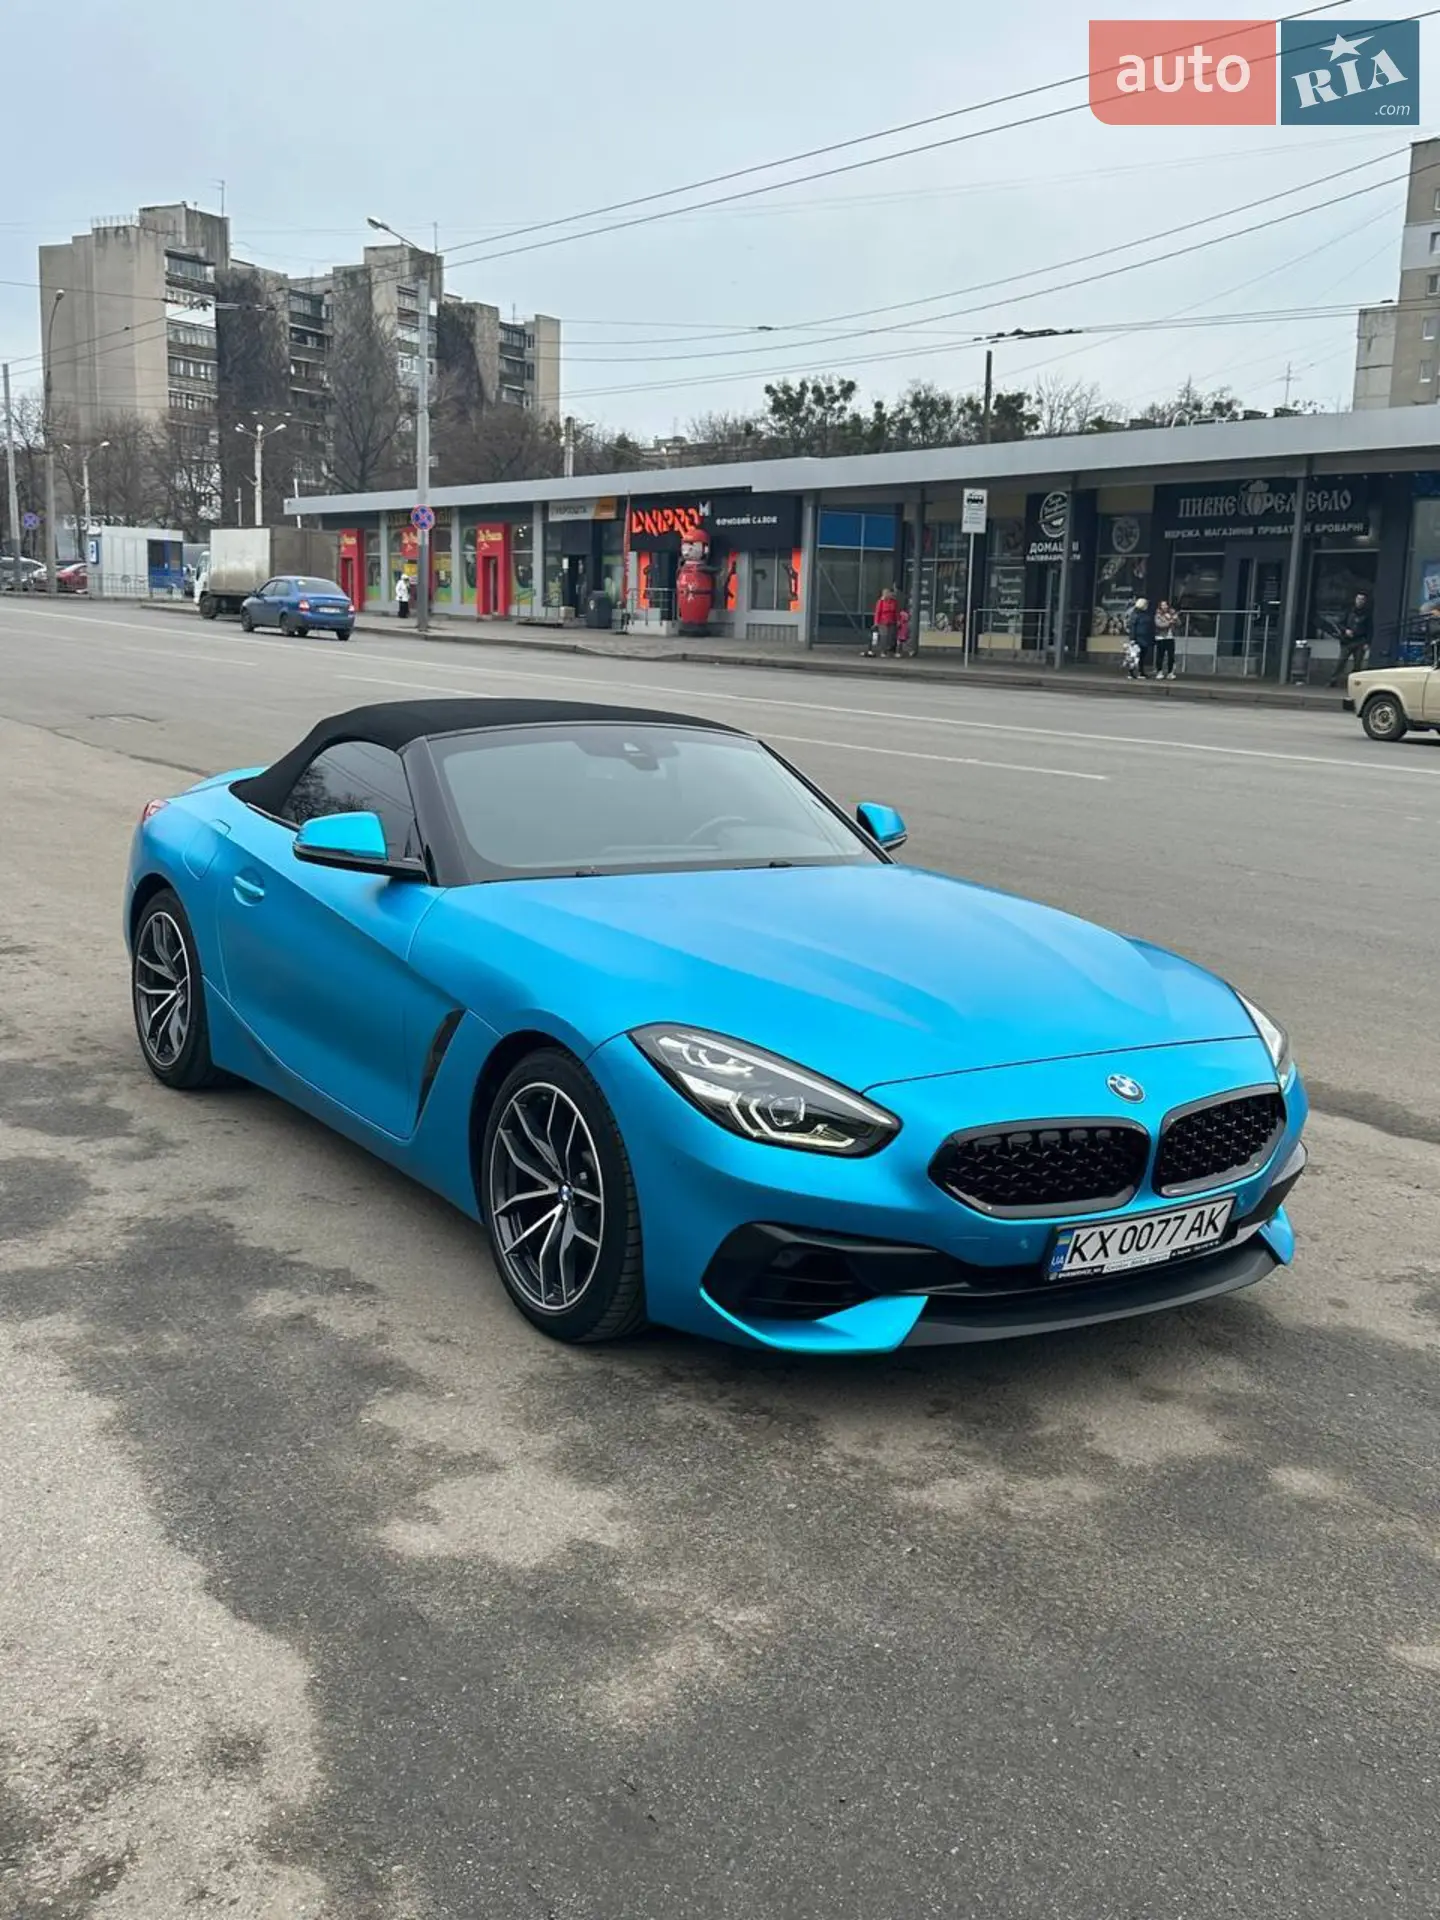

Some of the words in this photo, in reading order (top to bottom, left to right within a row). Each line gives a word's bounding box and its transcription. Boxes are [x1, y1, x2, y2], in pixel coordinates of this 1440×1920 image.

[1178, 495, 1237, 518] ПИВНЕ
[1068, 1227, 1118, 1264] KX
[1119, 1214, 1187, 1255] 0077
[1185, 1203, 1228, 1241] AK
[1051, 1255, 1065, 1267] UA
